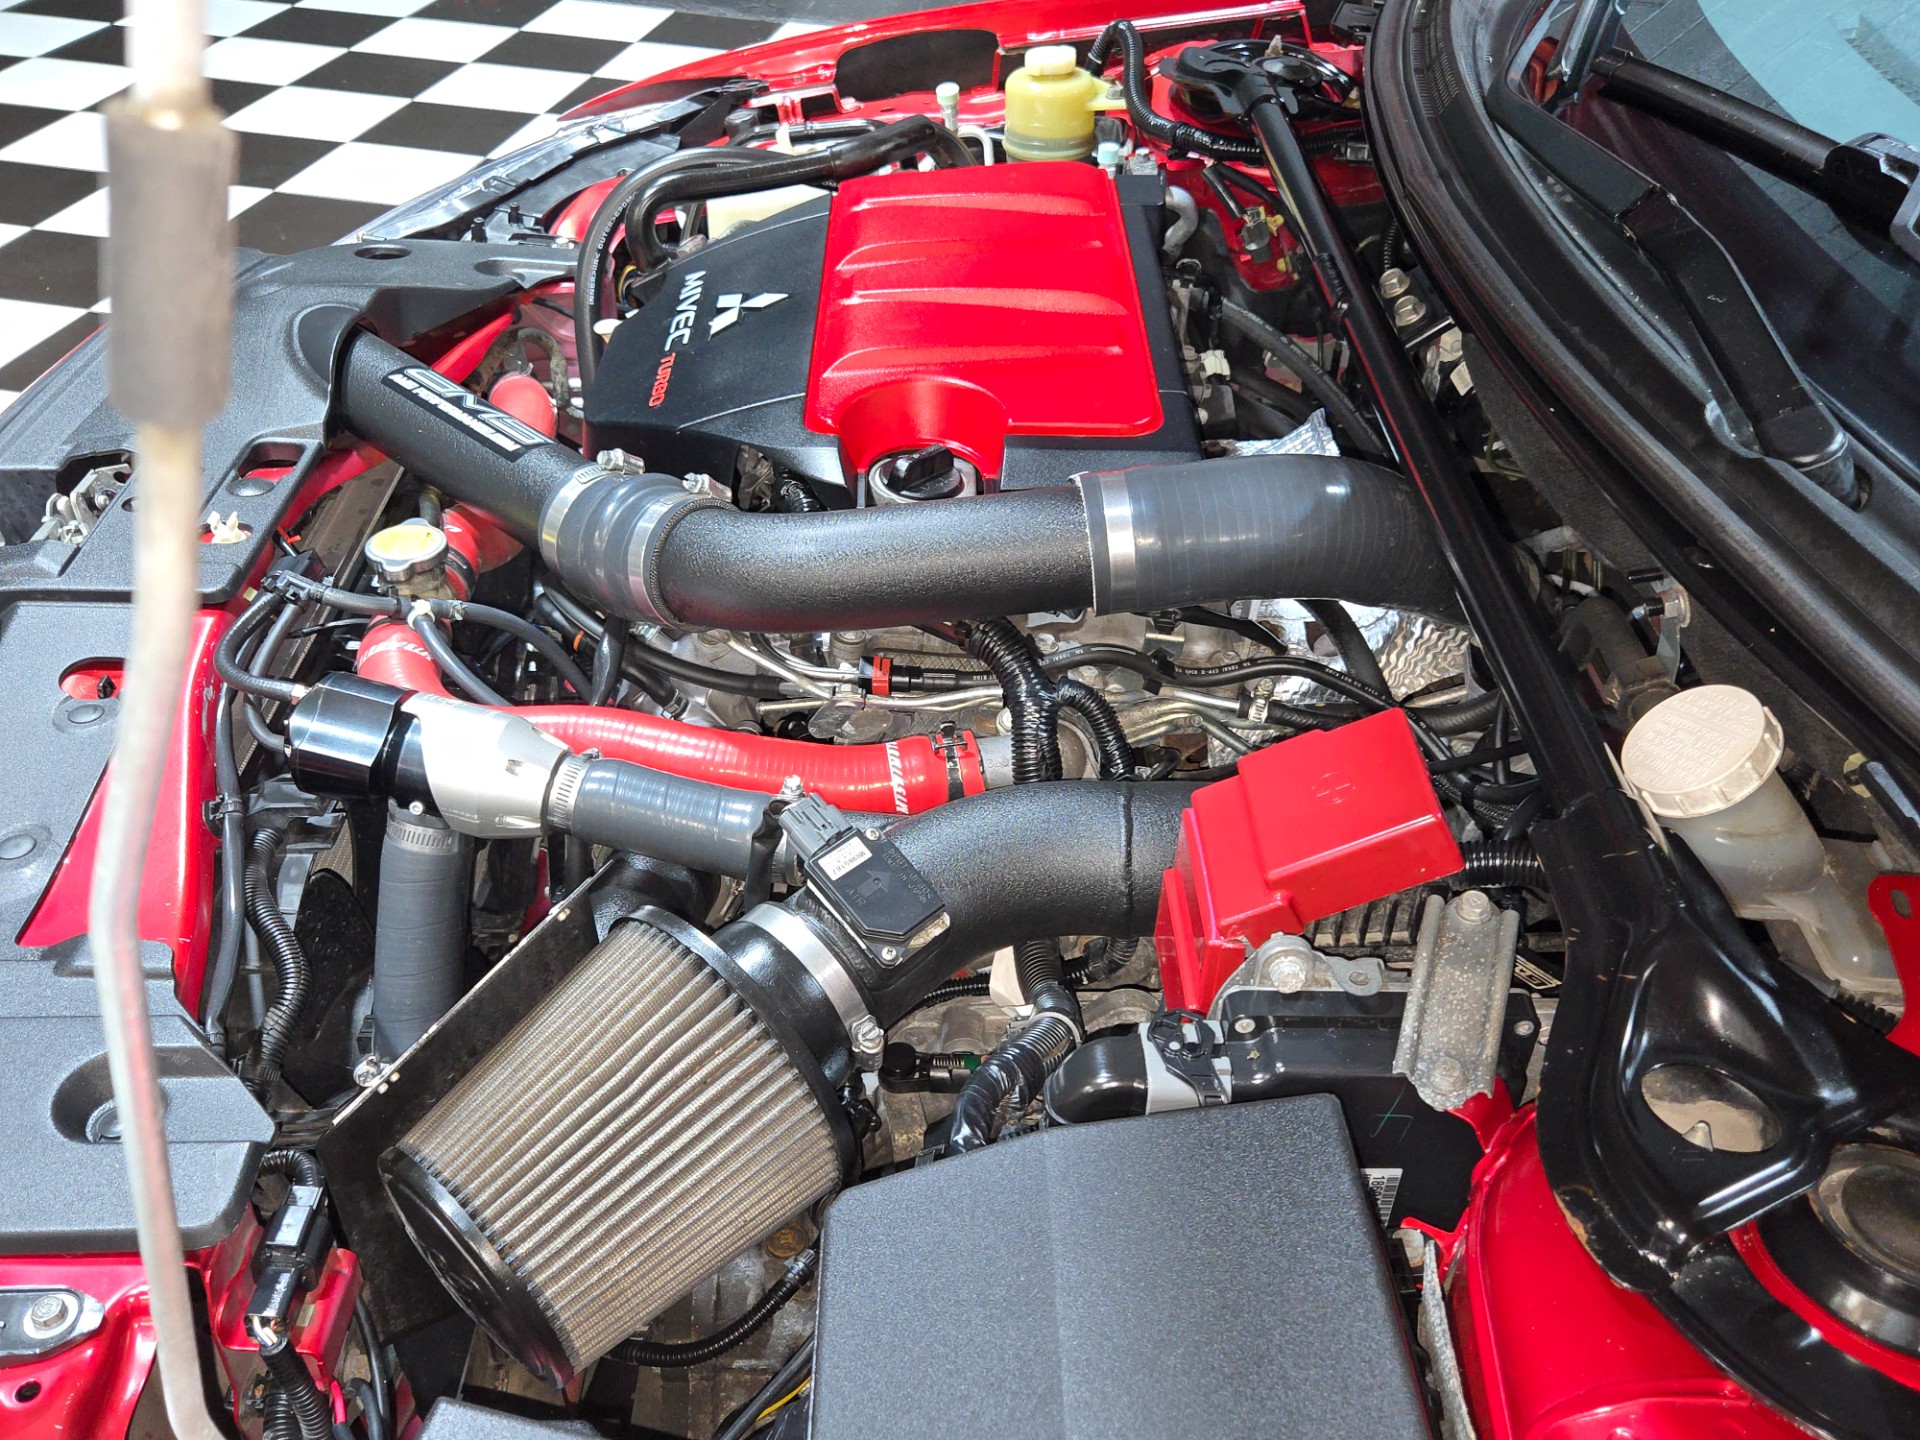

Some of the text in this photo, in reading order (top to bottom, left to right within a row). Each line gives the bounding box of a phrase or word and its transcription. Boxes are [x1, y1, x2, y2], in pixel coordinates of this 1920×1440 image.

[648, 269, 707, 408] MIVEC TURBO
[845, 887, 867, 907] AIR
